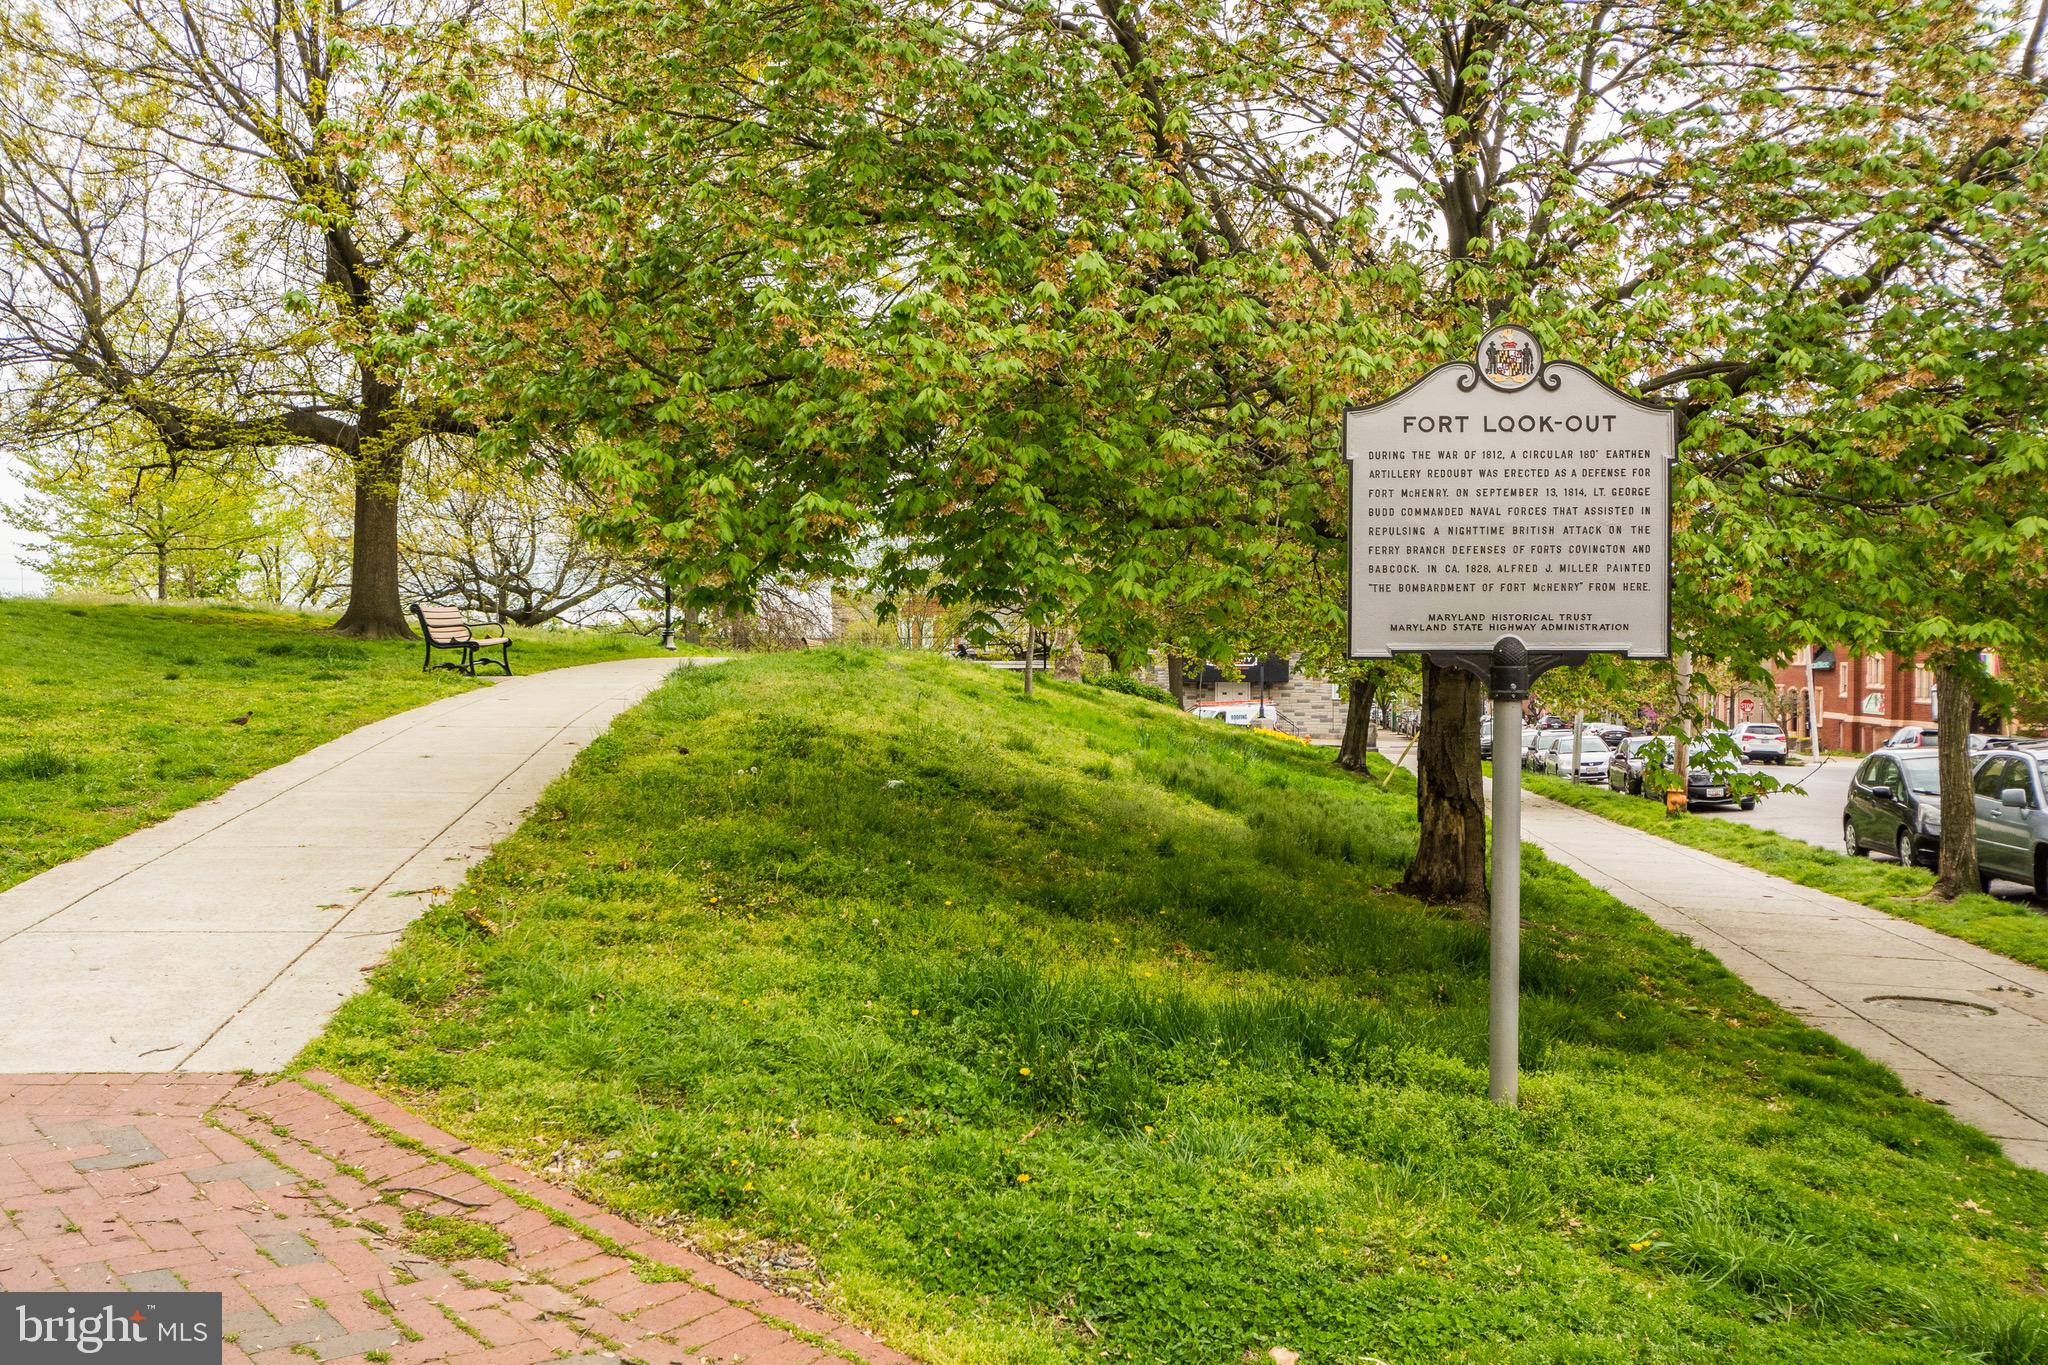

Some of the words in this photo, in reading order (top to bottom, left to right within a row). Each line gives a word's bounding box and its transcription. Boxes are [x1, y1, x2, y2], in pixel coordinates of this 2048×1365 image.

[1402, 415, 1470, 434] FORT
[1482, 414, 1618, 434] LOOK-OUT
[1368, 450, 1405, 460] DURING
[1411, 450, 1431, 460] THE
[1437, 450, 1458, 460] WAR
[1464, 450, 1477, 460] OF
[1482, 450, 1505, 460] 1812,
[1510, 450, 1517, 459] A
[1522, 449, 1574, 460] CIRCULAR
[1606, 449, 1651, 459] EARTHEN
[1368, 469, 1422, 479] ARTILLERY
[1427, 468, 1473, 478] REDOUBT
[1478, 468, 1499, 478] WAS
[1504, 468, 1550, 478] ERECTED
[1554, 468, 1567, 478] AS
[1570, 468, 1577, 478] A
[1581, 468, 1627, 478] DEFENSE
[1632, 467, 1651, 477] FOR
[1368, 488, 1395, 498] FORT
[1400, 488, 1449, 498] McHENRY.
[1456, 488, 1469, 498] ON
[1475, 487, 1539, 497] SEPTEMBER
[1546, 487, 1558, 498] 13,
[1564, 487, 1587, 497] 1814,
[1593, 487, 1606, 497] LT.
[1611, 487, 1651, 497] GEORGE
[1368, 507, 1395, 517] BUDD
[1400, 507, 1464, 517] COMMANDED
[1470, 506, 1502, 516] NAVAL
[1507, 506, 1547, 516] FORCES
[1552, 506, 1579, 516] THAT
[1584, 506, 1634, 516] ASSISTED
[1641, 506, 1651, 515] IN
[1368, 526, 1426, 536] REPULSING
[1433, 526, 1440, 536] A
[1447, 526, 1505, 536] NIGHTTIME
[1512, 525, 1555, 535] BRITISH
[1562, 525, 1602, 535] ATTACK
[1608, 525, 1622, 535] ON
[1630, 525, 1651, 535] THE
[1368, 545, 1400, 555] FERRY
[1406, 545, 1445, 555] BRANCH
[1452, 545, 1506, 555] DEFENSES
[1512, 544, 1525, 554] OF
[1530, 544, 1562, 555] FORTS
[1568, 544, 1626, 554] COVINGTON
[1632, 544, 1651, 554] AND
[1368, 564, 1420, 574] BABCOCK.
[1427, 564, 1437, 574] IN
[1444, 564, 1460, 574] CA.
[1466, 564, 1491, 574] 1828,
[1496, 563, 1538, 574] ALFRED
[1545, 563, 1553, 573] J.
[1559, 563, 1598, 573] MILLER
[1606, 563, 1651, 573] PAINTED
[1398, 583, 1476, 593] BOMBARDMENT
[1481, 582, 1495, 593] OF
[1499, 582, 1527, 592] FORT
[1588, 582, 1616, 592] FROM
[1622, 582, 1651, 592] HERE.
[1428, 613, 1486, 622] MARYLAND
[1491, 613, 1555, 622] HISTORICAL
[1559, 613, 1593, 622] TRUST
[1389, 623, 1448, 632] MARYLAND
[1452, 623, 1484, 632] STATE
[1488, 623, 1537, 632] HIGHWAY
[1540, 623, 1630, 632] ADMINISTRATION
[1740, 702, 1754, 710] STOP
